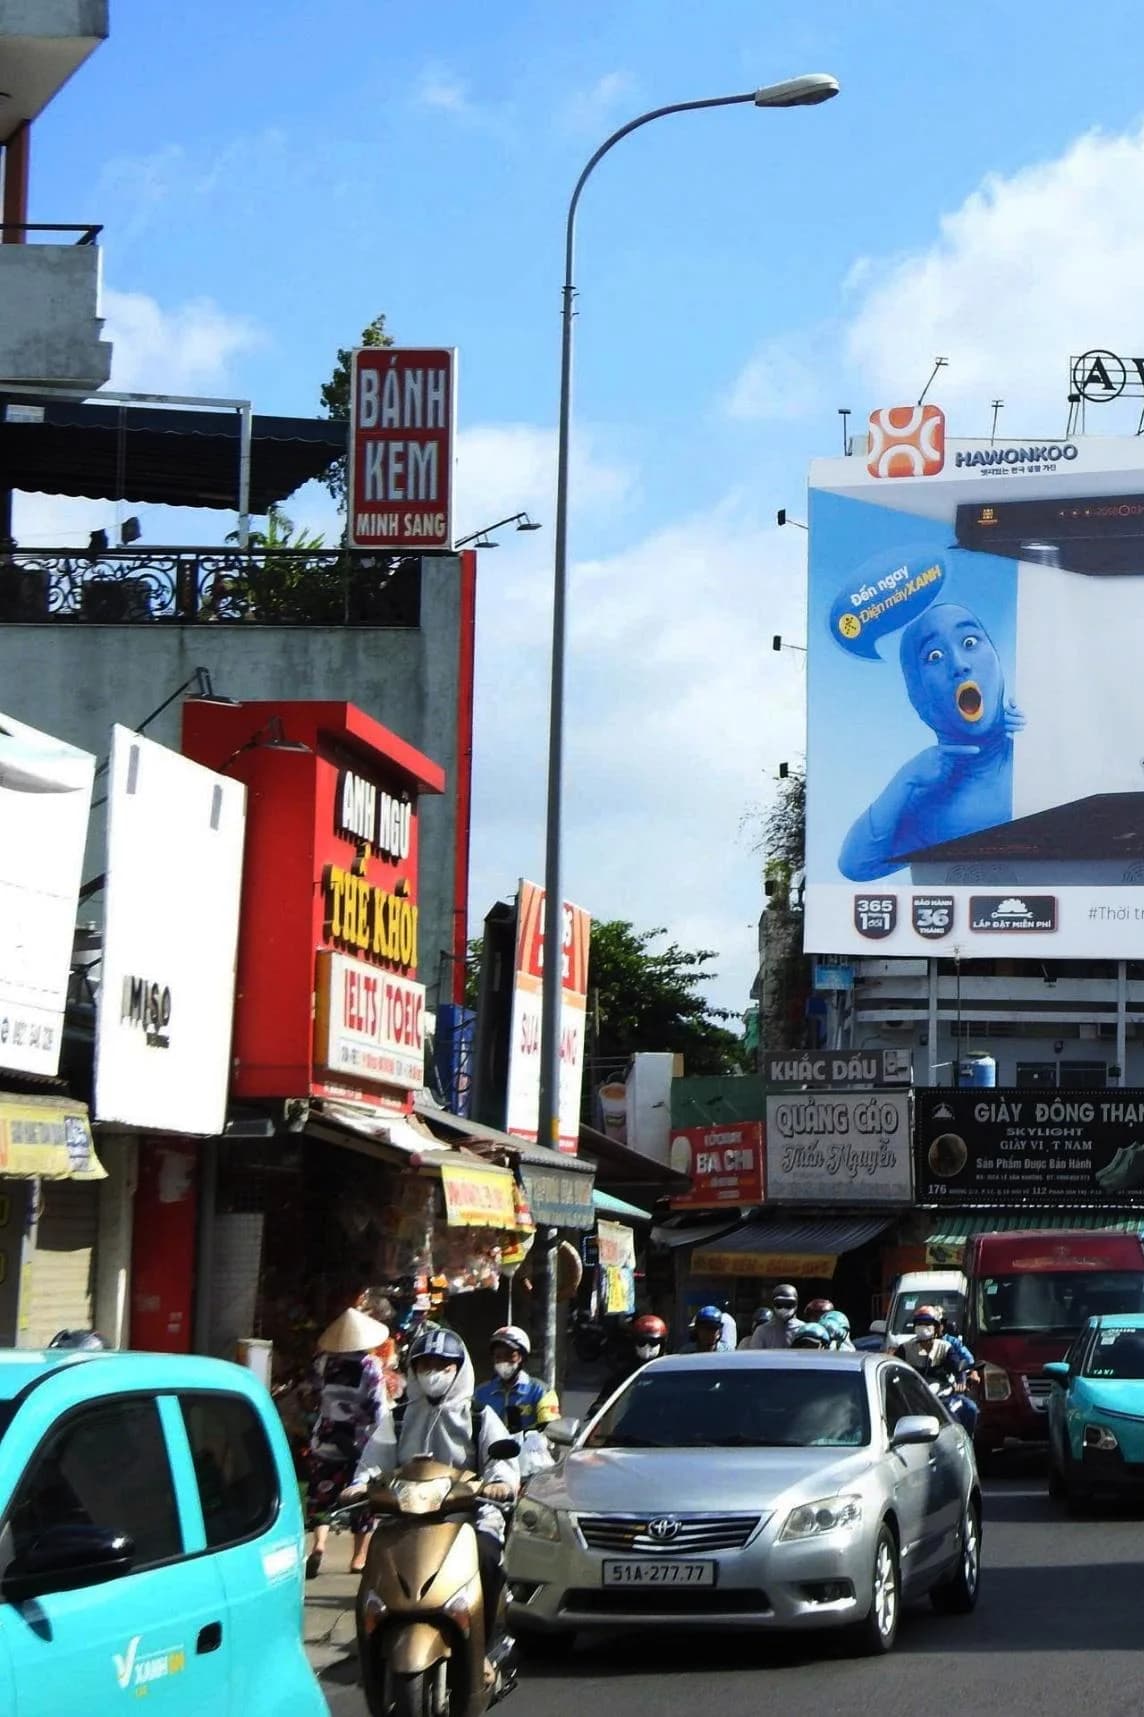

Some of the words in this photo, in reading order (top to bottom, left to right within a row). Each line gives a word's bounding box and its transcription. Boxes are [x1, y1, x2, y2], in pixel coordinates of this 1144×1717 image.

[359, 355, 445, 428] BÁNH
[955, 444, 1078, 468] HAWONKOO
[365, 440, 438, 500] KEM
[356, 513, 398, 536] MINH
[404, 513, 445, 537] SANG
[877, 566, 909, 590] ngay
[342, 770, 376, 842] ANH
[857, 900, 893, 911] 365
[917, 909, 949, 926] 36
[771, 1053, 826, 1081] KHẮC
[832, 1053, 877, 1081] DẤU
[777, 1096, 849, 1138] QUẢNG
[854, 1097, 899, 1135] CÁO
[974, 1097, 1022, 1122] GIÀY
[1035, 1097, 1095, 1122] ĐÔNG
[1006, 1128, 1084, 1136] SKYLIGHT
[1000, 1139, 1027, 1150] GIÀY
[1065, 1141, 1092, 1150] NAM
[928, 1184, 947, 1195] 176
[1032, 1187, 1047, 1195] 112
[613, 1565, 705, 1581] 51A-277.77
